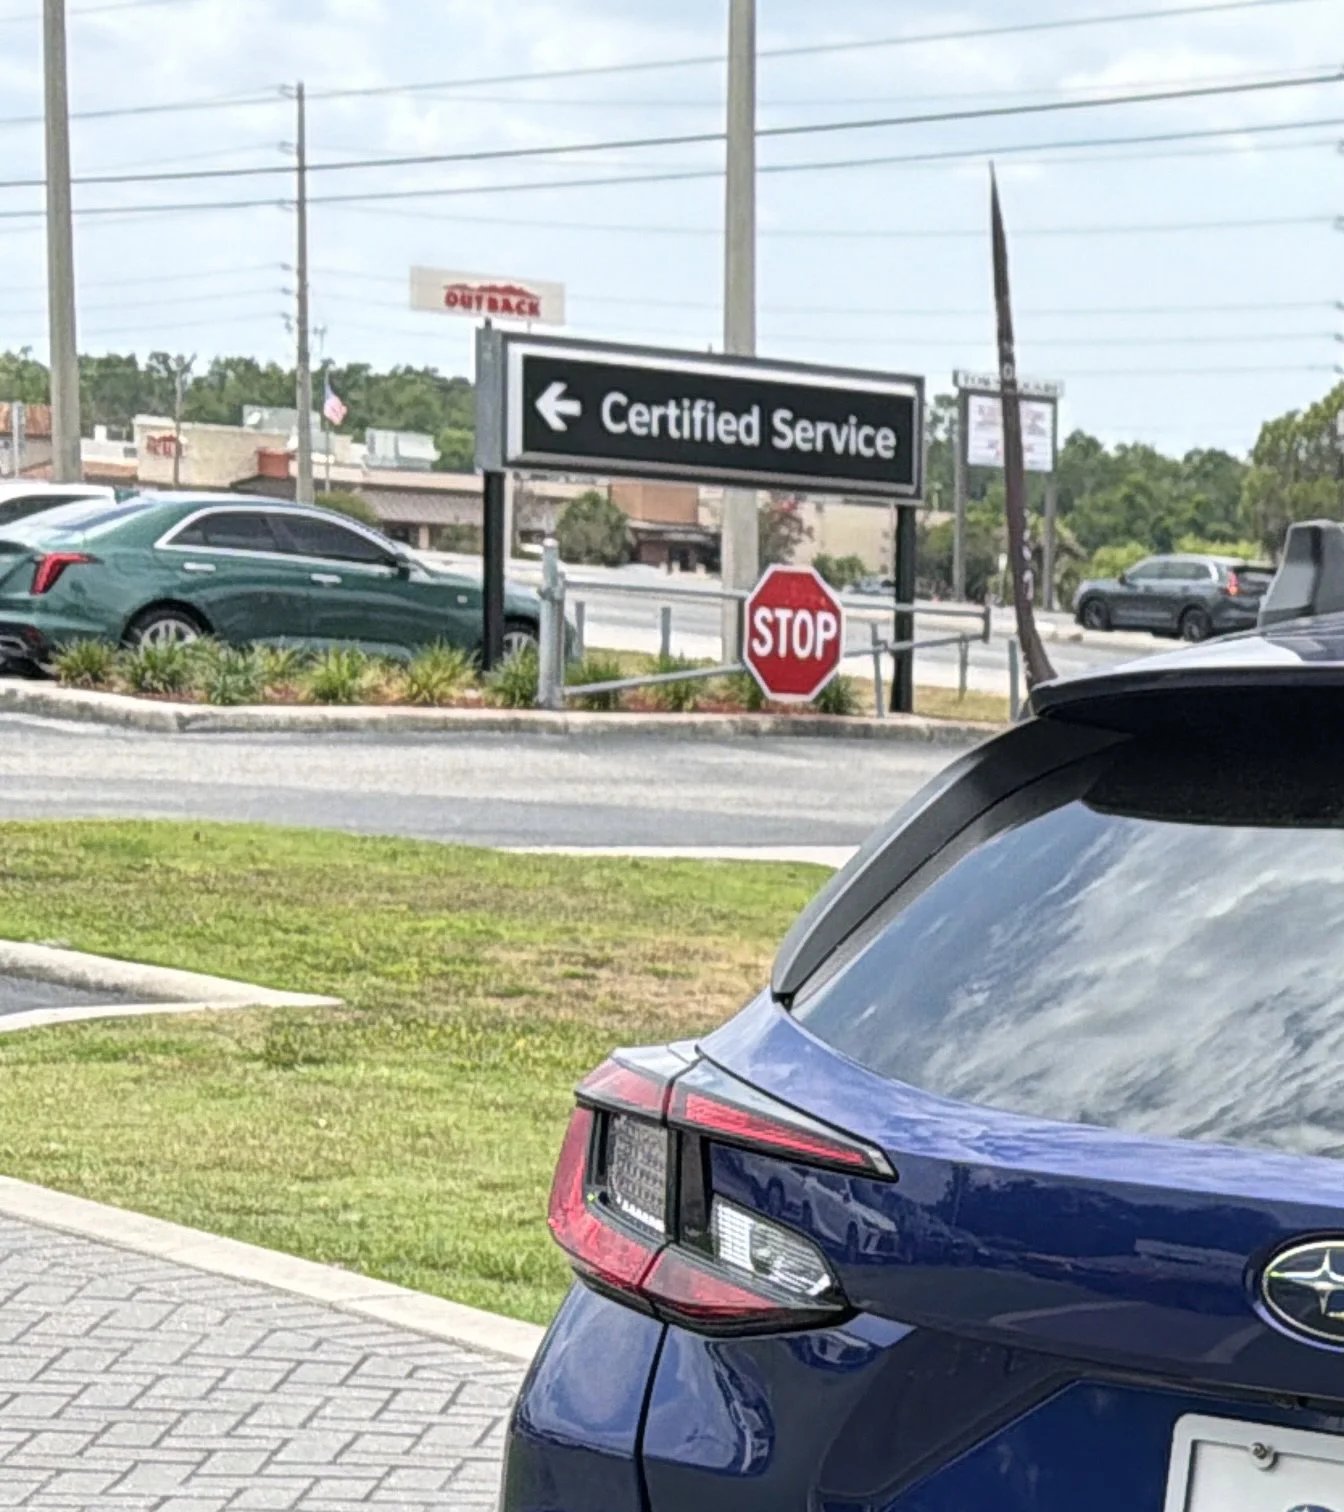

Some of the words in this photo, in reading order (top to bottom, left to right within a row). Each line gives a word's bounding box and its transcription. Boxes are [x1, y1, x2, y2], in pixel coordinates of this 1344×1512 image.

[444, 291, 541, 318] OUTBACK
[601, 391, 760, 447] Certified
[771, 408, 897, 460] Service
[751, 605, 837, 661] STOP
